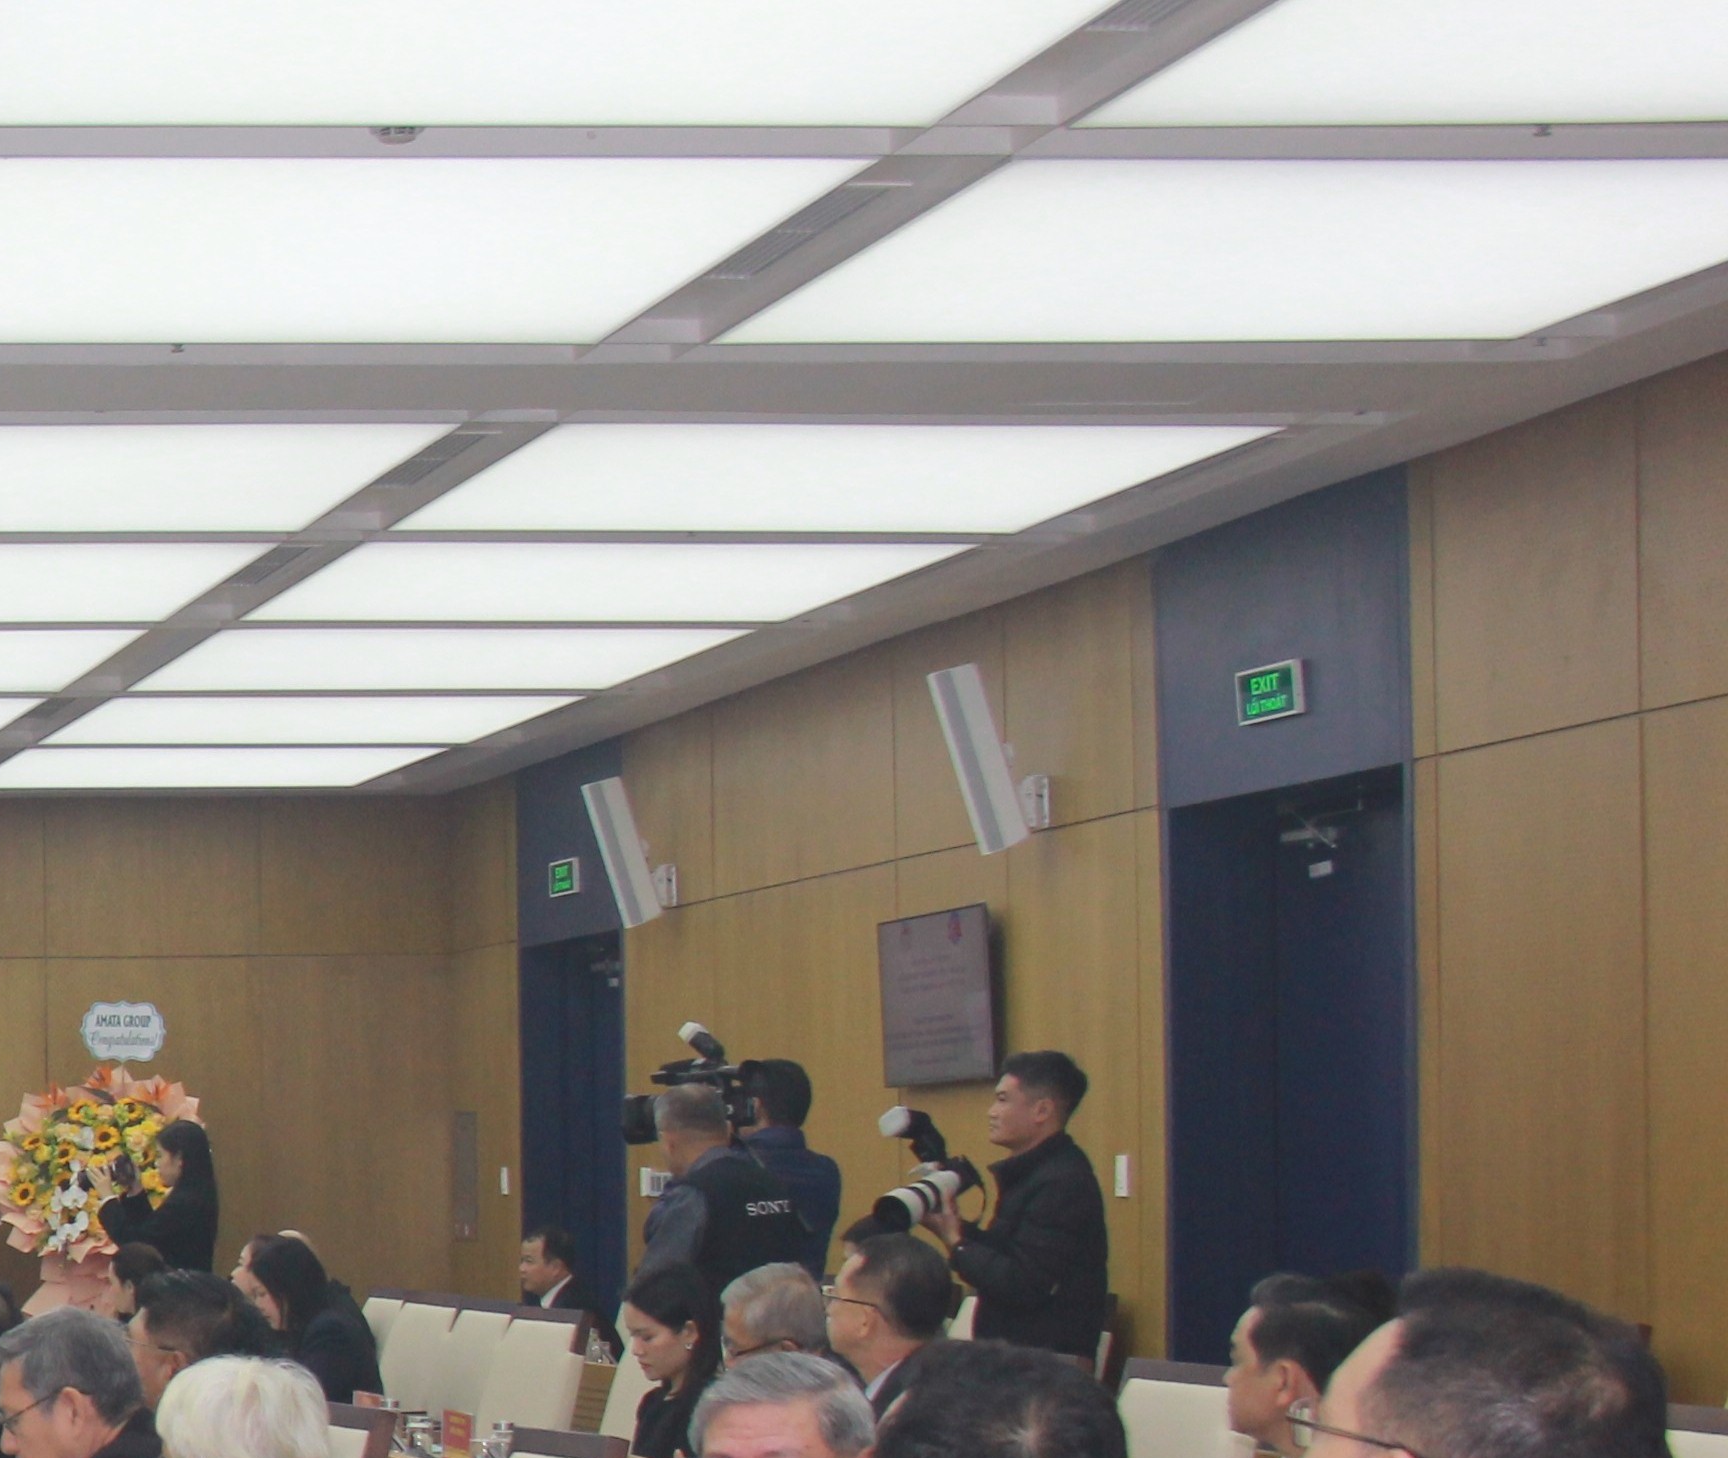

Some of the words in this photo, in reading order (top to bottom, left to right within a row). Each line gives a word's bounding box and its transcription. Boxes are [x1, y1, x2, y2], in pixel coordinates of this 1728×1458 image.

[1250, 672, 1279, 695] EXIT
[95, 1014, 121, 1028] AMATA
[124, 1014, 151, 1028] GROUP
[746, 1199, 791, 1216] SONY
